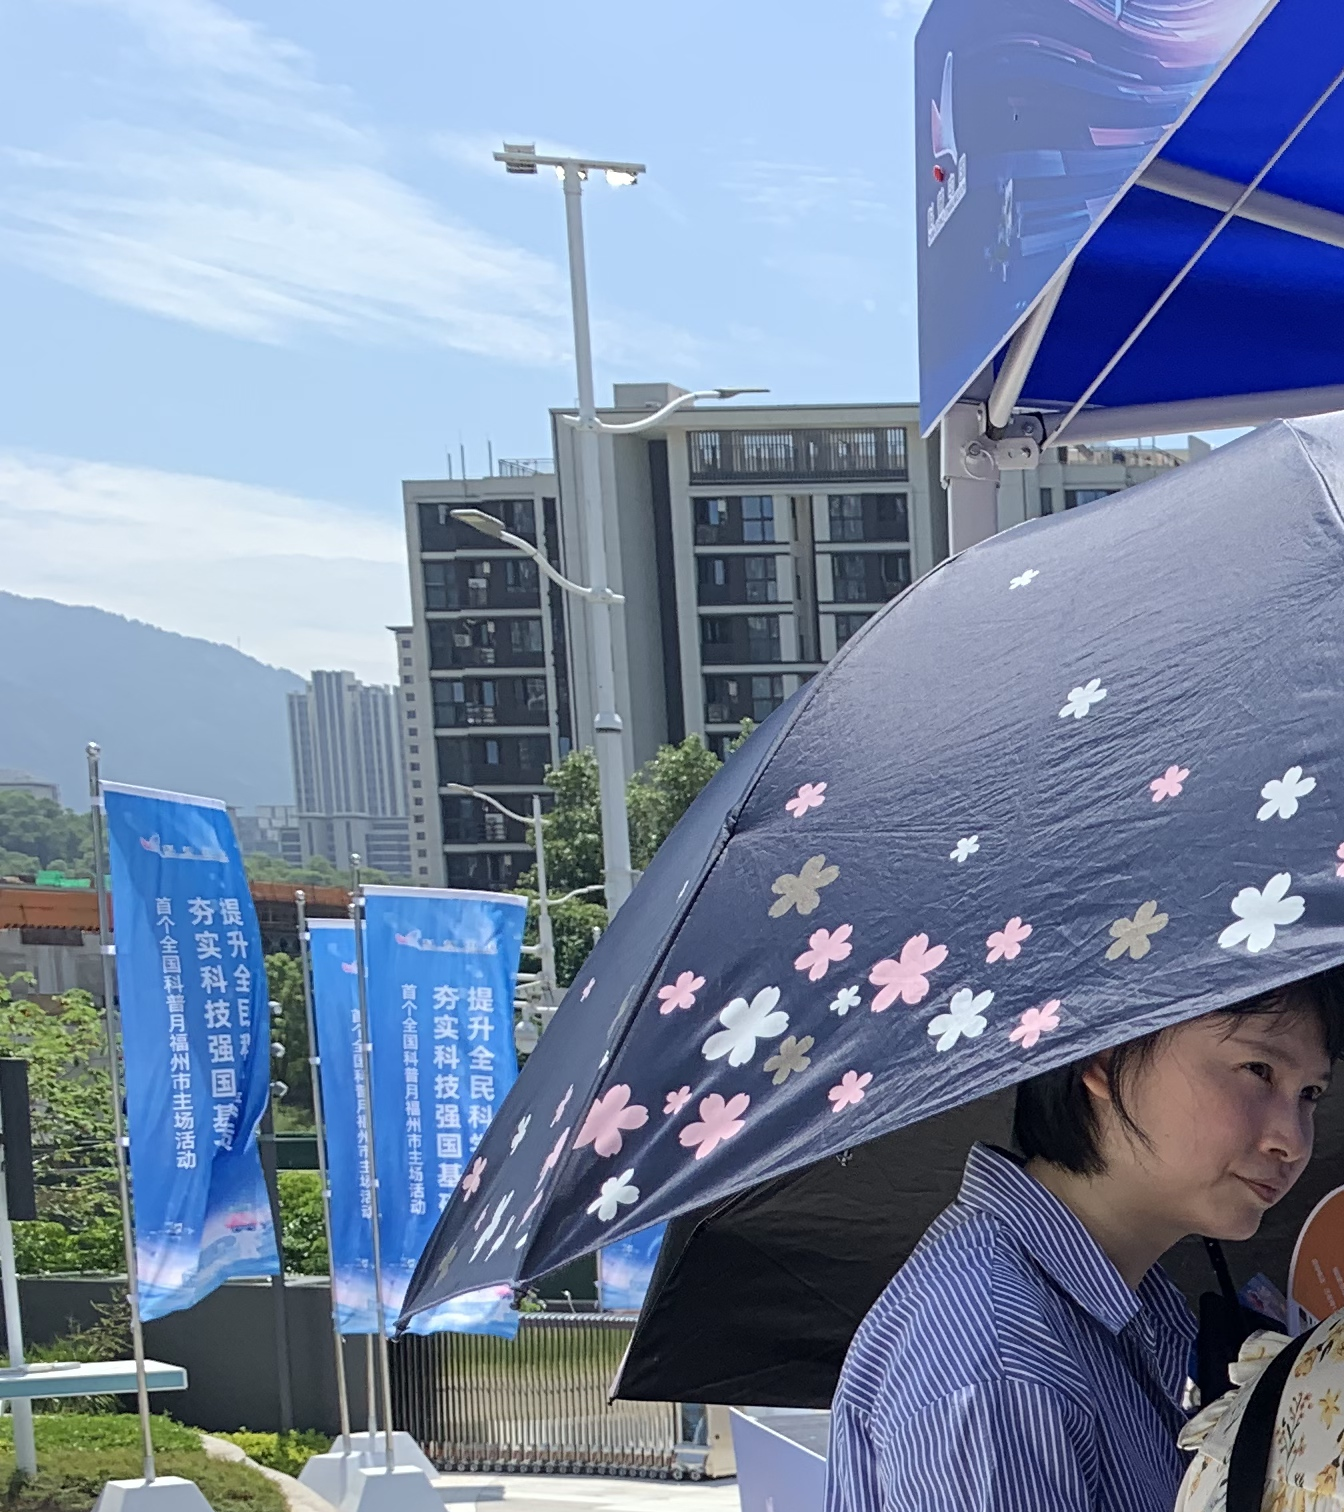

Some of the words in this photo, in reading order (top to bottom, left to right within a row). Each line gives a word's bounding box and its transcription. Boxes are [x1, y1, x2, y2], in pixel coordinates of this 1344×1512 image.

[154, 897, 197, 1170] 首个全国科普月福州市主场活动
[401, 984, 426, 1216] 首个全国科普月福州市主场活动
